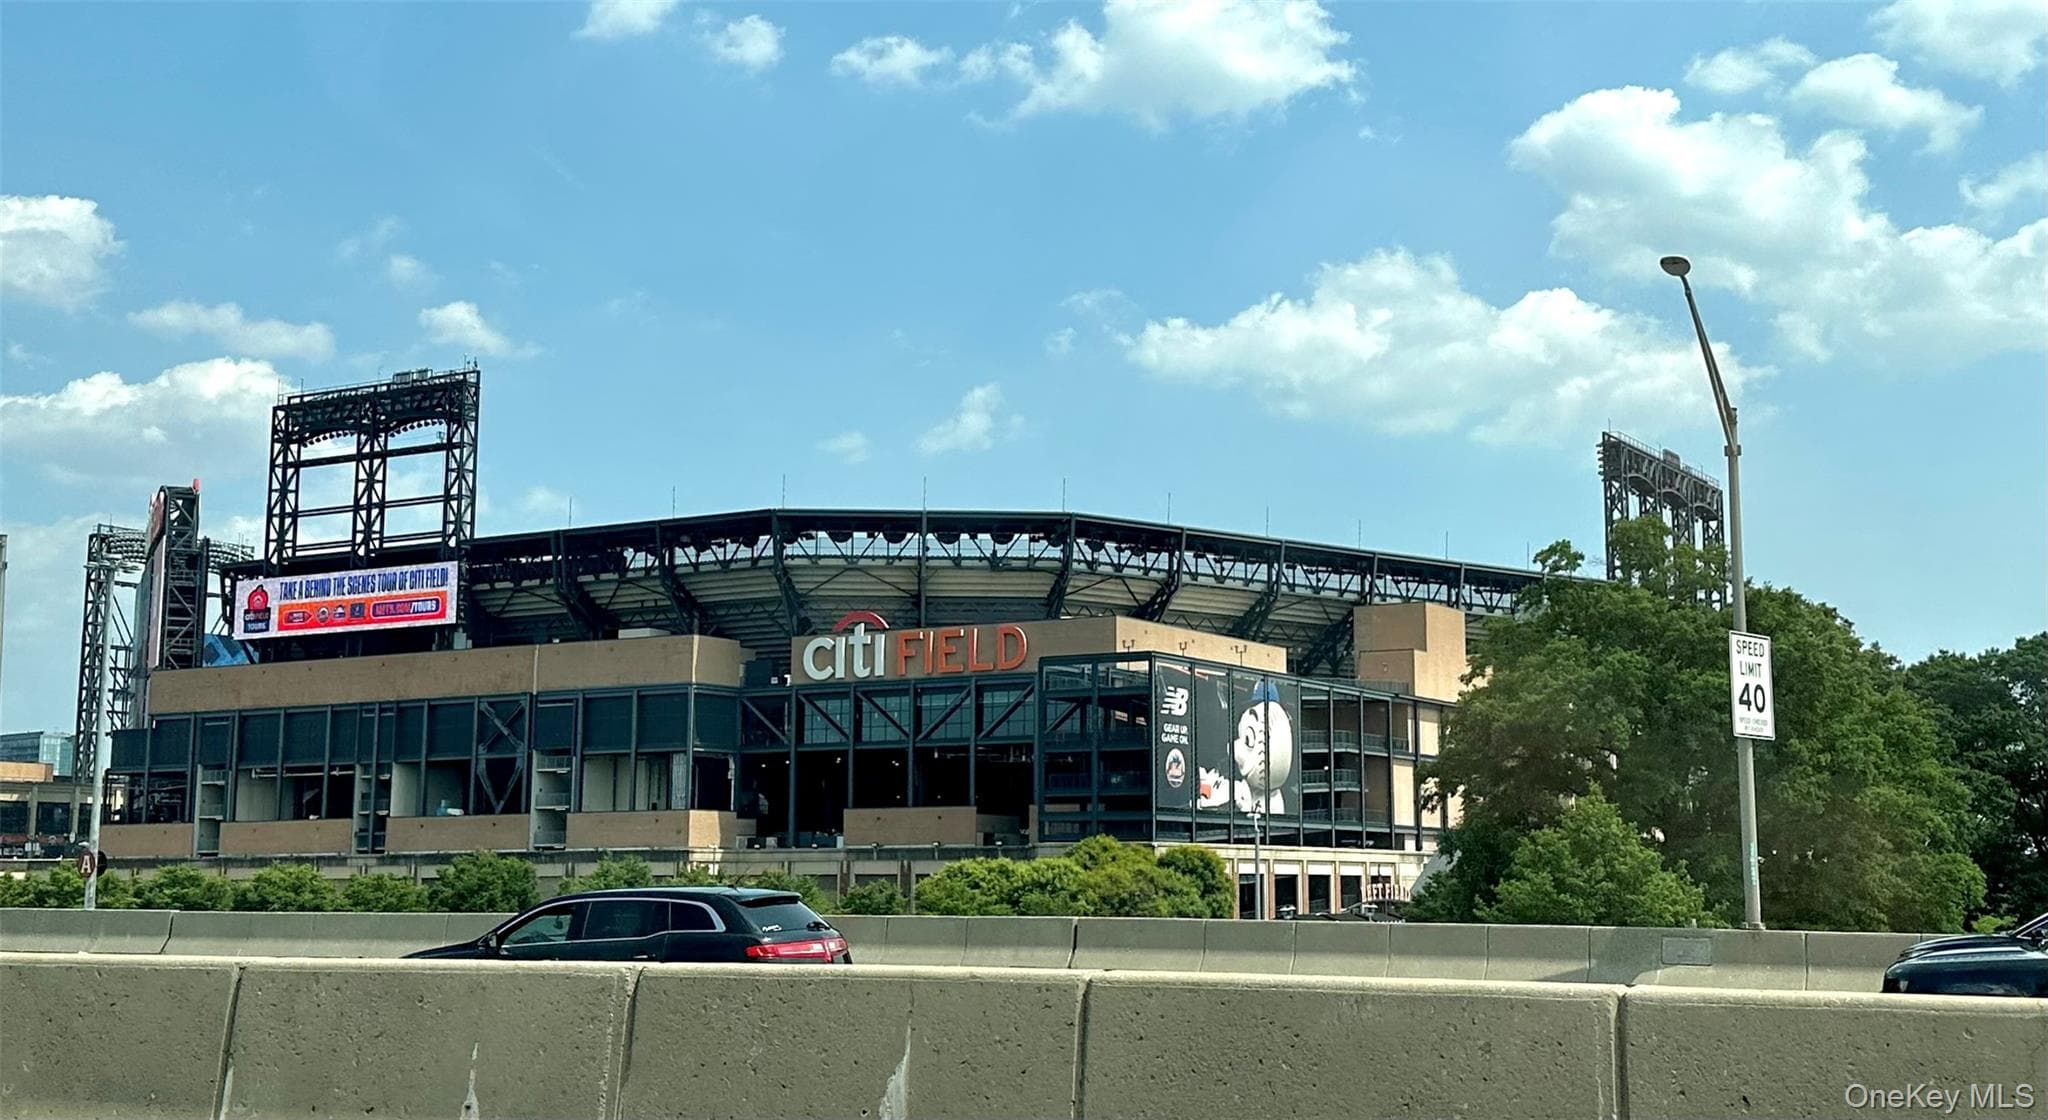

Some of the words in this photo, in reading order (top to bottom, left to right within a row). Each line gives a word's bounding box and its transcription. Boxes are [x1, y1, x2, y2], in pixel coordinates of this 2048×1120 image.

[280, 581, 297, 600] TAKE
[305, 578, 331, 598] BEHIND
[333, 576, 346, 596] THE
[347, 573, 376, 596] SCENES
[378, 571, 397, 592] TOUR
[399, 570, 408, 591] OF
[409, 569, 425, 590] CITI
[802, 622, 886, 681] citi
[896, 624, 1028, 676] FIELD
[1736, 639, 1765, 658] SPEED
[1739, 660, 1762, 678] LIMIT
[1738, 682, 1766, 713] 40
[1161, 732, 1179, 744] GAME
[81, 855, 92, 874] A
